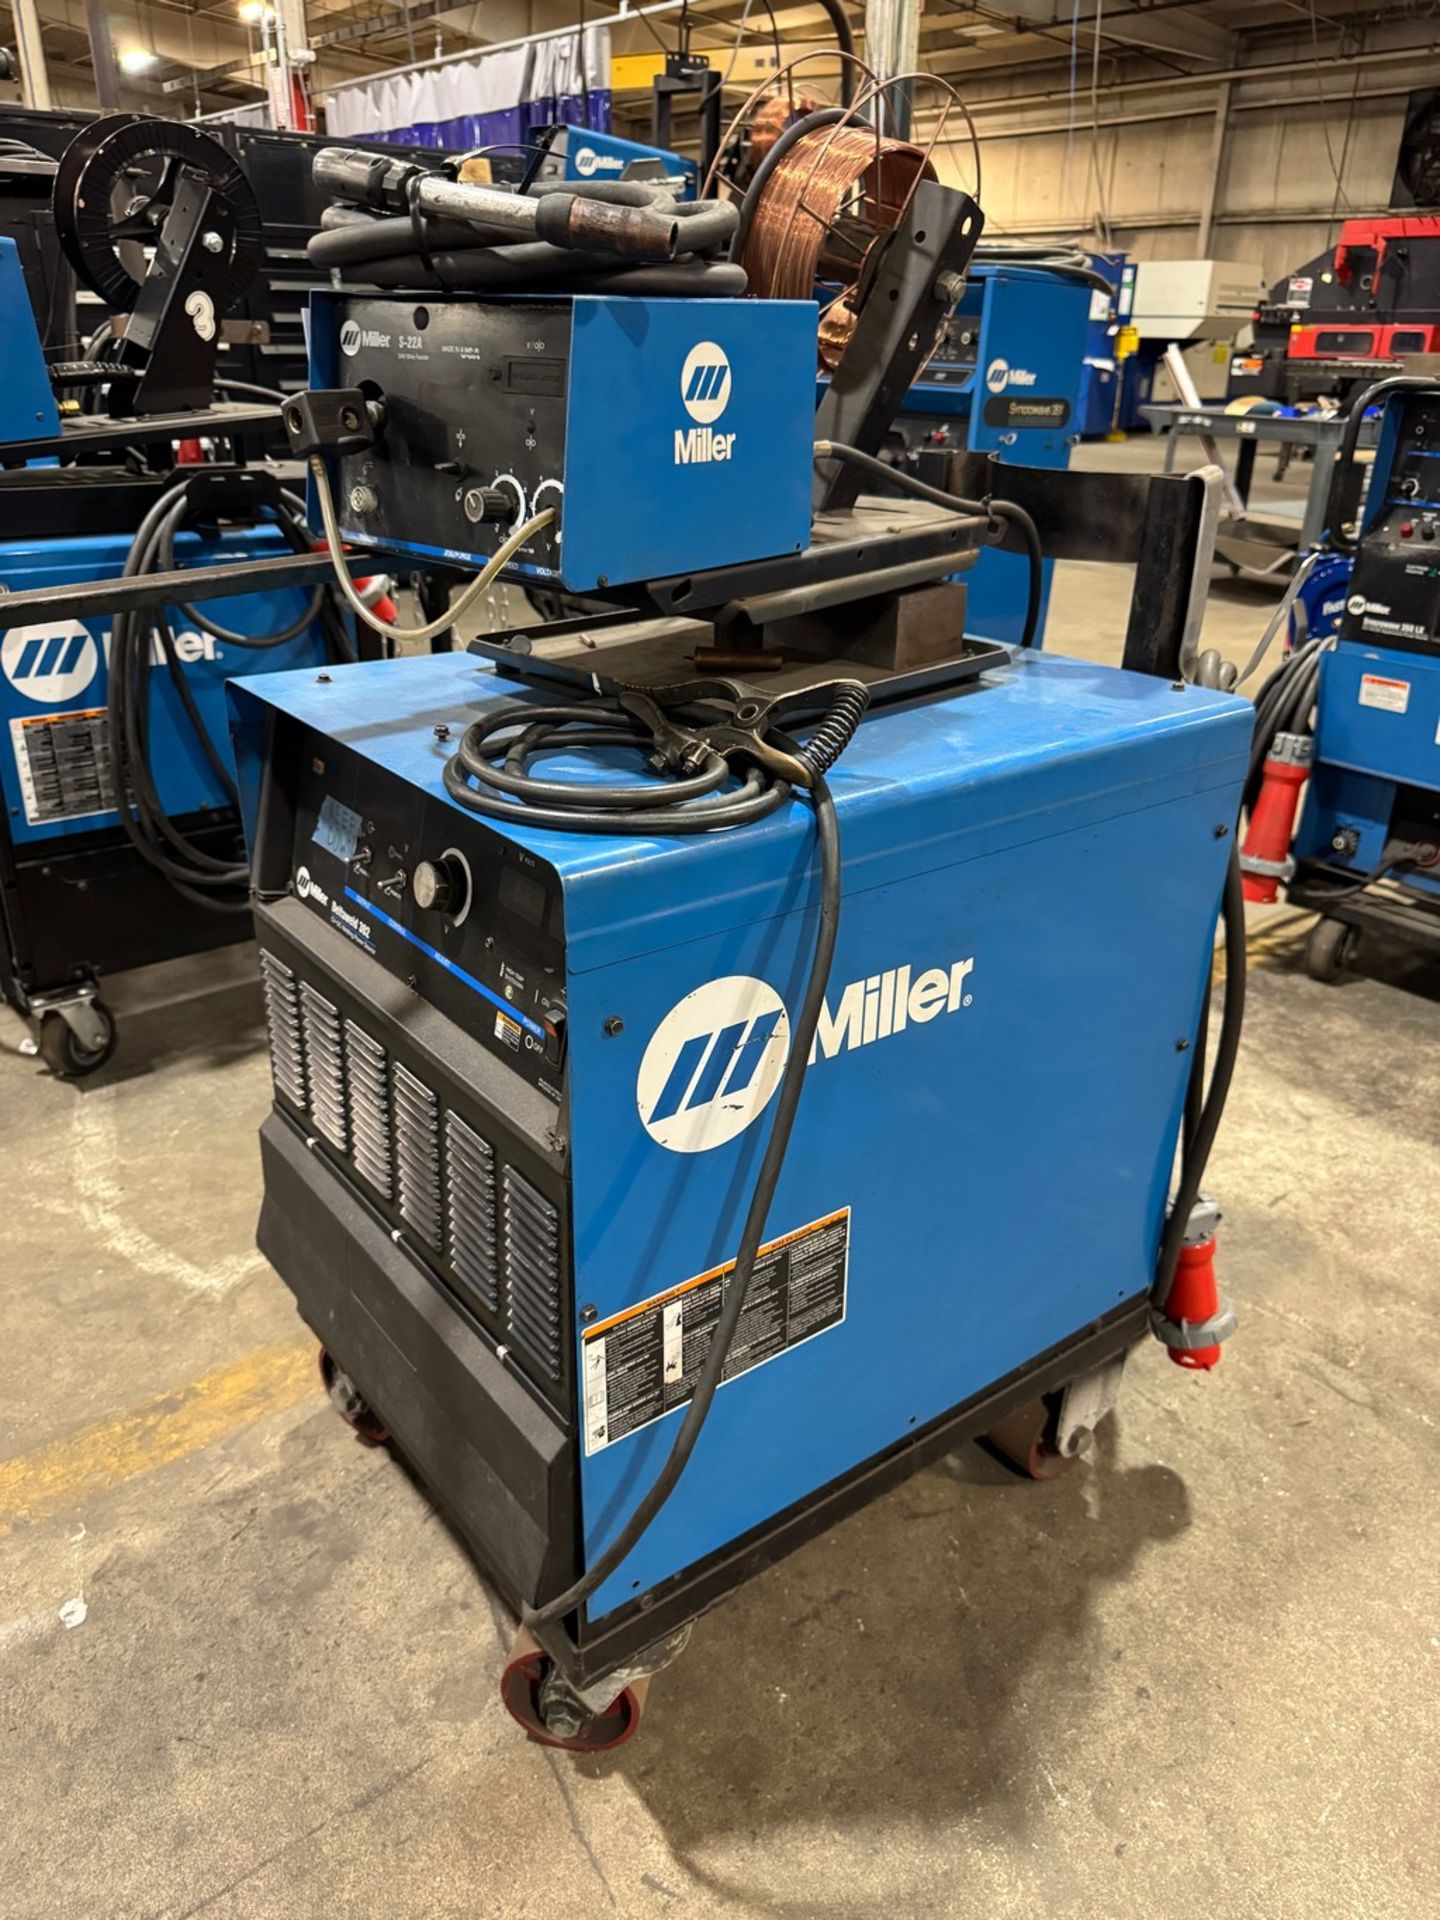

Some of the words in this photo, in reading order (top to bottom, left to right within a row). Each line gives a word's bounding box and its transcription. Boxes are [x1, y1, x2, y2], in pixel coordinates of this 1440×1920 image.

[362, 330, 391, 348] Miller
[398, 335, 423, 350] S-22A
[1008, 369, 1037, 386] Miller
[674, 427, 736, 465] Miller
[1365, 602, 1391, 615] Miller
[309, 881, 329, 907] Miller
[807, 957, 974, 1066] Miller
